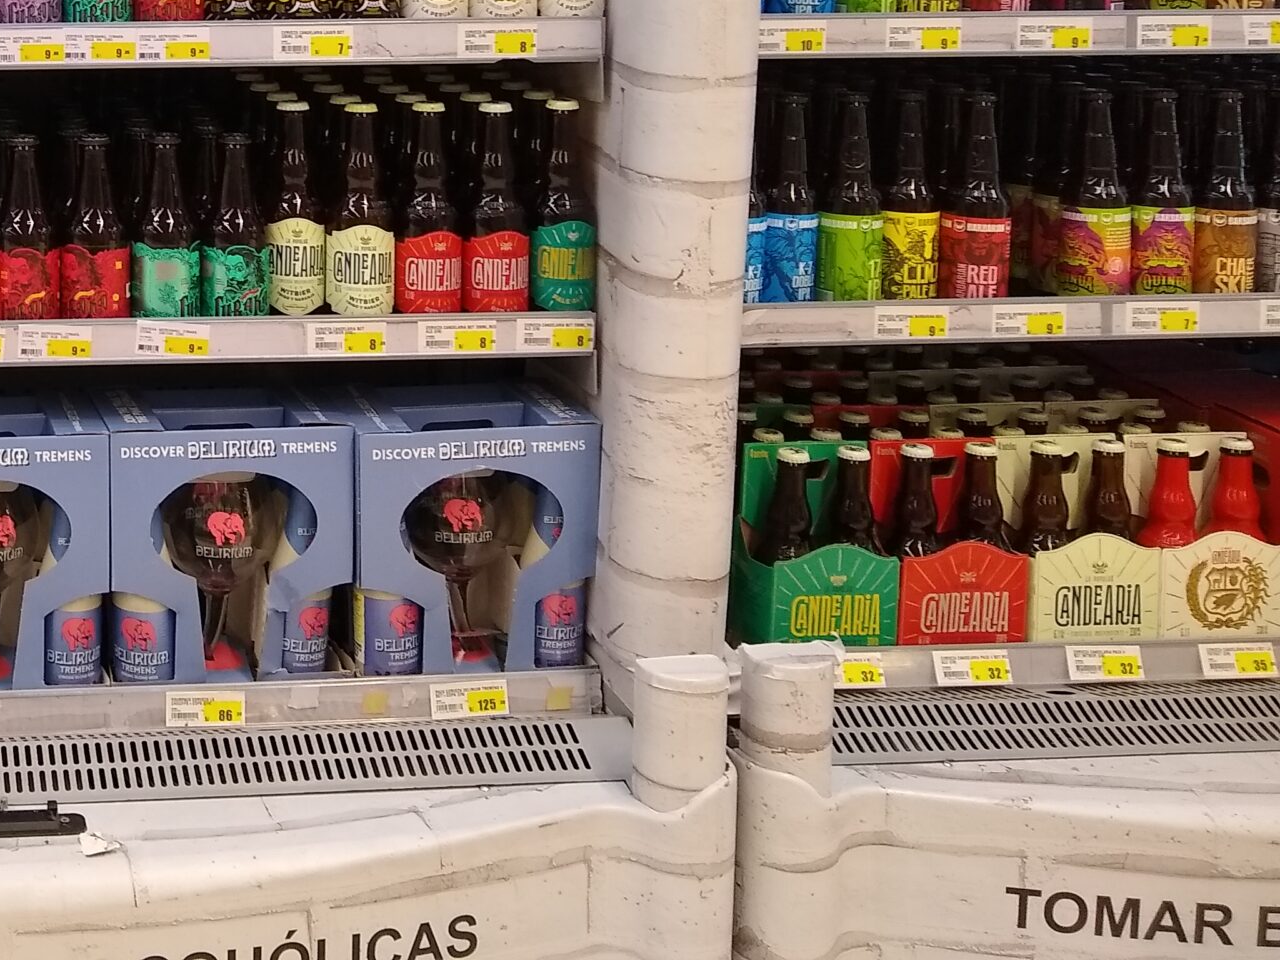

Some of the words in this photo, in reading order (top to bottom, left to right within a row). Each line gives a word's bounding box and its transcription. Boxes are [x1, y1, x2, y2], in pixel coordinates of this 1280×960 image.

[902, 0, 928, 12] PALE
[929, 0, 950, 12] ALE
[801, 40, 812, 50] 10
[799, 262, 814, 275] K-7
[1217, 257, 1245, 275] CHA
[969, 265, 997, 284] RED
[1215, 276, 1246, 293] SKI
[281, 288, 311, 297] WITBIER
[903, 286, 927, 299] PALE
[349, 296, 380, 305] WITBIER
[120, 446, 184, 459] DISCOVER
[187, 440, 277, 460] DELIRIUM
[282, 442, 337, 454] TREMENS
[372, 447, 436, 460] DISCOVER
[439, 440, 526, 460] DELIRIUM
[532, 440, 586, 454] TREMENS
[34, 450, 92, 463] TREMENS
[434, 531, 493, 544] DELIRIUM
[196, 544, 253, 559] DELIRIUM
[541, 640, 576, 649] TREMENS
[59, 664, 94, 674] TREMENS
[122, 664, 157, 674] TREMENS
[1120, 662, 1134, 675] 32
[1254, 659, 1268, 671] 35
[862, 671, 875, 682] 32
[988, 667, 1002, 679] 32
[478, 699, 497, 710] 125
[218, 710, 233, 721] 86
[1005, 886, 1234, 946] TOMAR
